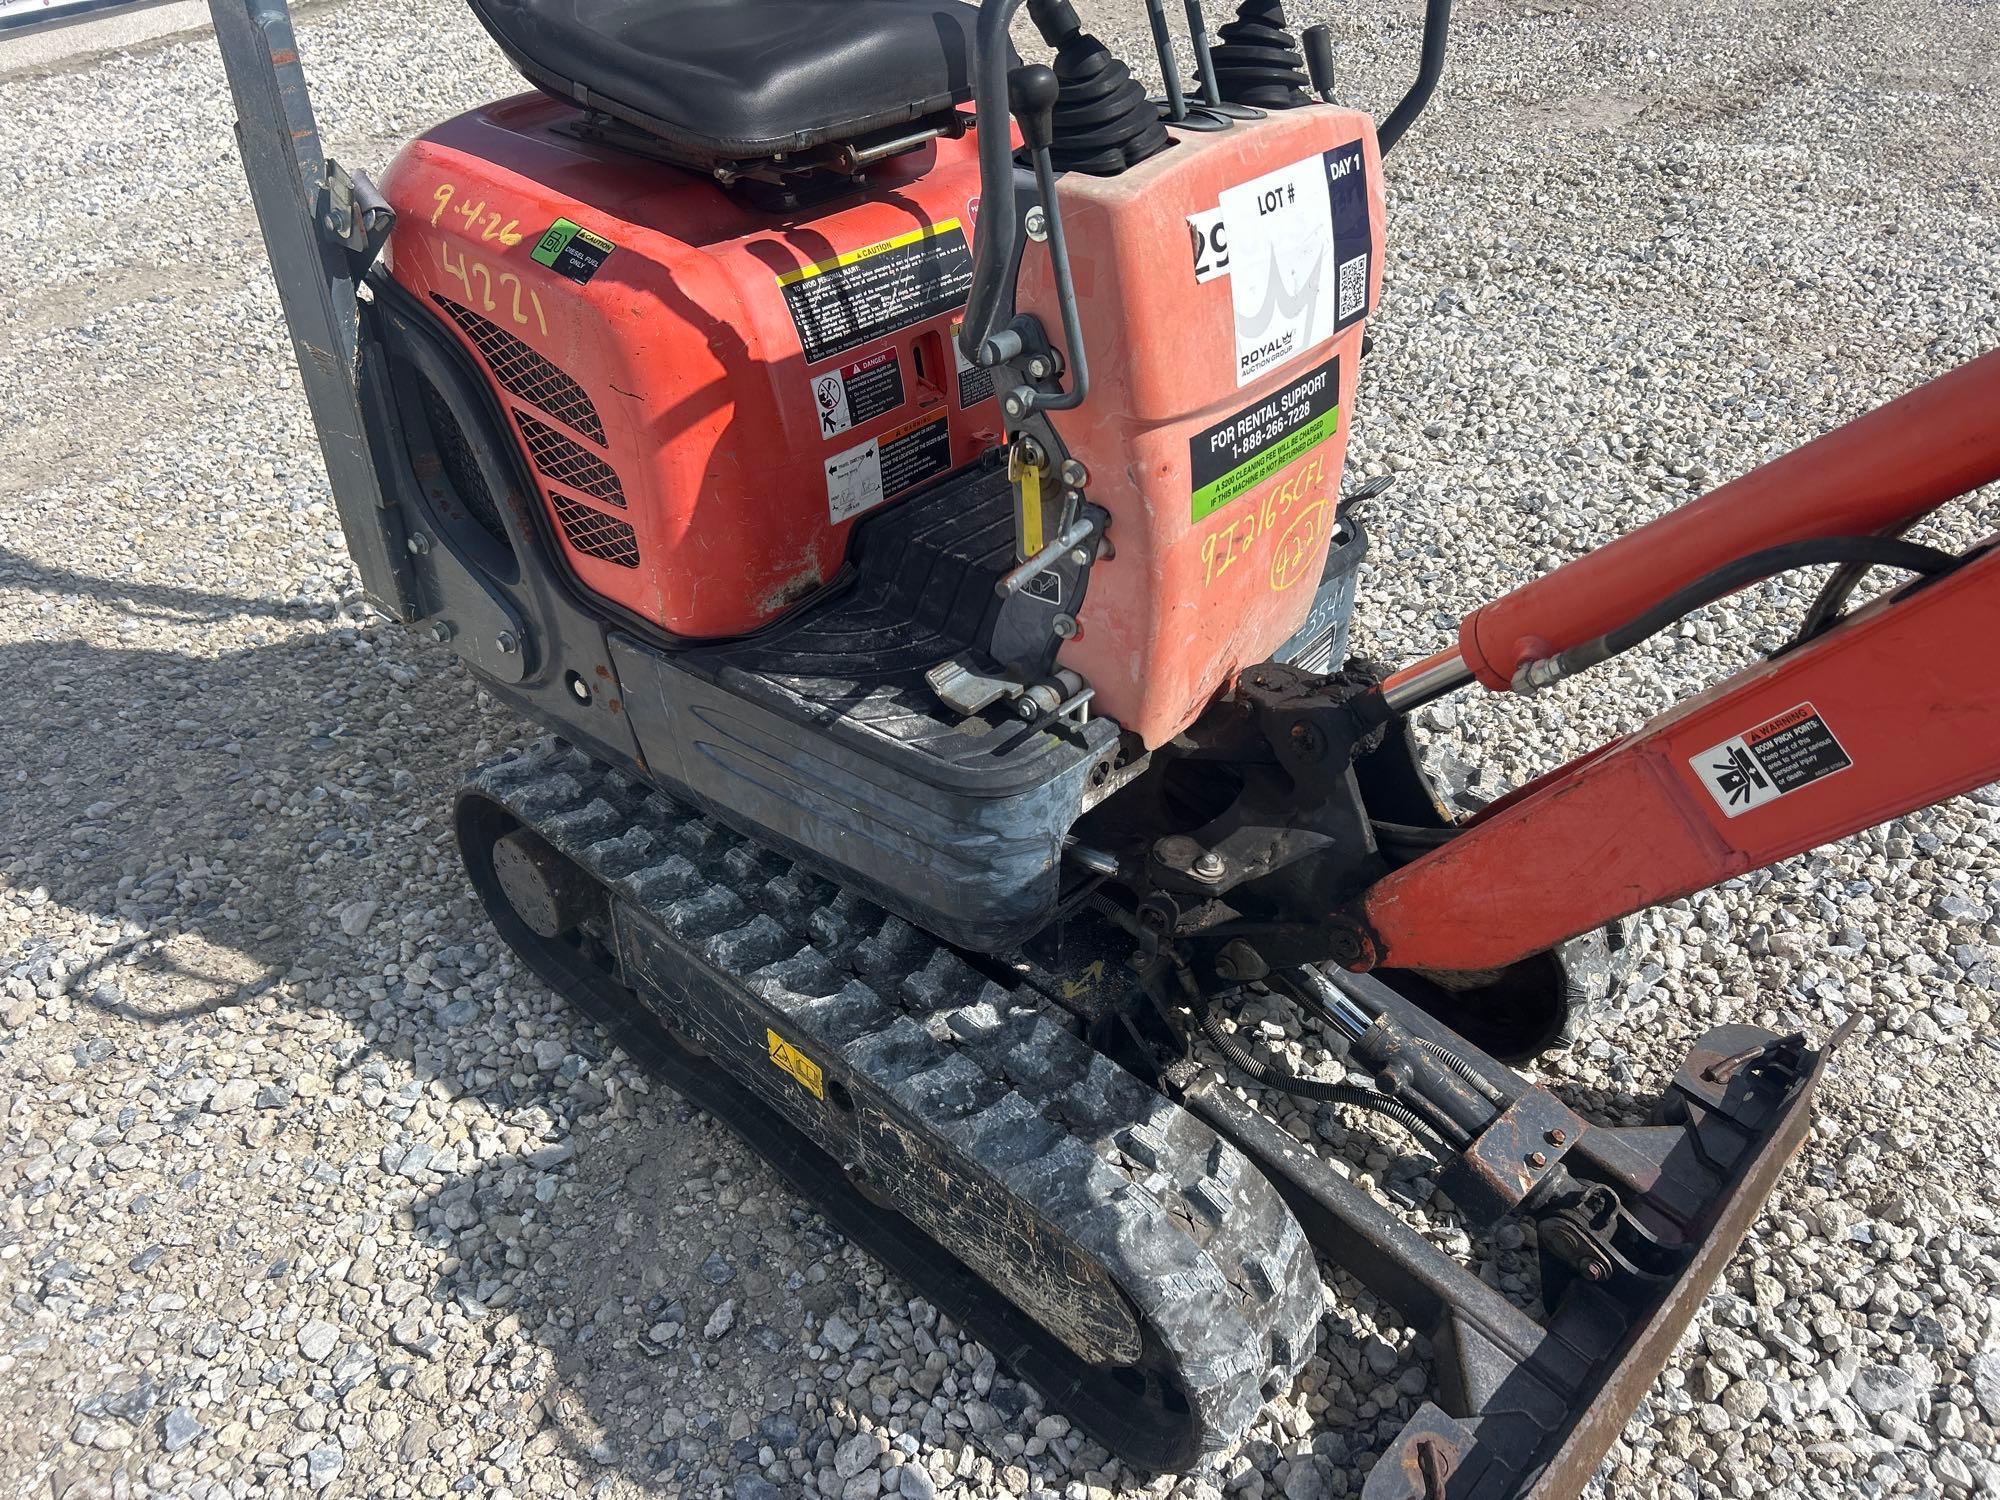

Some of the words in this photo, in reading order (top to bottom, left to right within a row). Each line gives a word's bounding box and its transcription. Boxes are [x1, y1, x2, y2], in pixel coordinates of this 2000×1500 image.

[1330, 156, 1352, 180] DAY
[1354, 154, 1360, 170] 1
[1258, 187, 1284, 216] LOT
[1287, 183, 1295, 204] #
[564, 246, 584, 260] DIESEL
[585, 256, 599, 268] FUEL
[586, 234, 612, 251] CAUTION
[862, 242, 892, 257] CAUTION
[570, 258, 585, 269] ONLY
[442, 241, 548, 336] 4221
[801, 279, 817, 290] AVOID
[817, 271, 843, 284] PERSONAL
[862, 354, 886, 369] DANGER
[1240, 338, 1282, 368] ROYAL
[1242, 358, 1270, 377] AUCTION
[1271, 345, 1293, 362] GROUP
[1210, 426, 1235, 452] FOR
[1237, 402, 1280, 438] RENTAL
[1281, 372, 1327, 412] SUPPORT
[1232, 401, 1310, 459] 1-888-266-7228
[1210, 496, 1217, 508] IF
[1217, 486, 1232, 503] THIS
[1232, 471, 1258, 495] MACHINE
[1260, 468, 1265, 477] IS
[1266, 460, 1278, 474] NOT
[1278, 442, 1306, 466] RETURNED
[1306, 430, 1324, 449] CLEAN
[1216, 484, 1220, 493] A
[1221, 476, 1235, 490] $200
[1236, 458, 1265, 483] CLEANING
[1265, 450, 1277, 464] FEE
[1277, 442, 1291, 457] WILL
[1291, 438, 1299, 448] BE
[1299, 420, 1324, 444] CHARGED
[1276, 503, 1325, 586] 4221
[1760, 708, 1808, 736] WARNING
[1754, 740, 1774, 754] BOOM
[1774, 732, 1793, 746] PINCH
[1794, 720, 1820, 736] POINTS:
[1762, 752, 1778, 762] Keep
[1780, 747, 1790, 756] out
[1791, 742, 1798, 751] of
[1798, 737, 1810, 747] this
[1768, 760, 1782, 770] area
[1782, 756, 1790, 764] to
[1791, 748, 1808, 762] avoid
[1808, 738, 1832, 752] serious
[1772, 763, 1799, 779] personal
[1800, 754, 1817, 768] injury
[1786, 770, 1805, 782] death.
